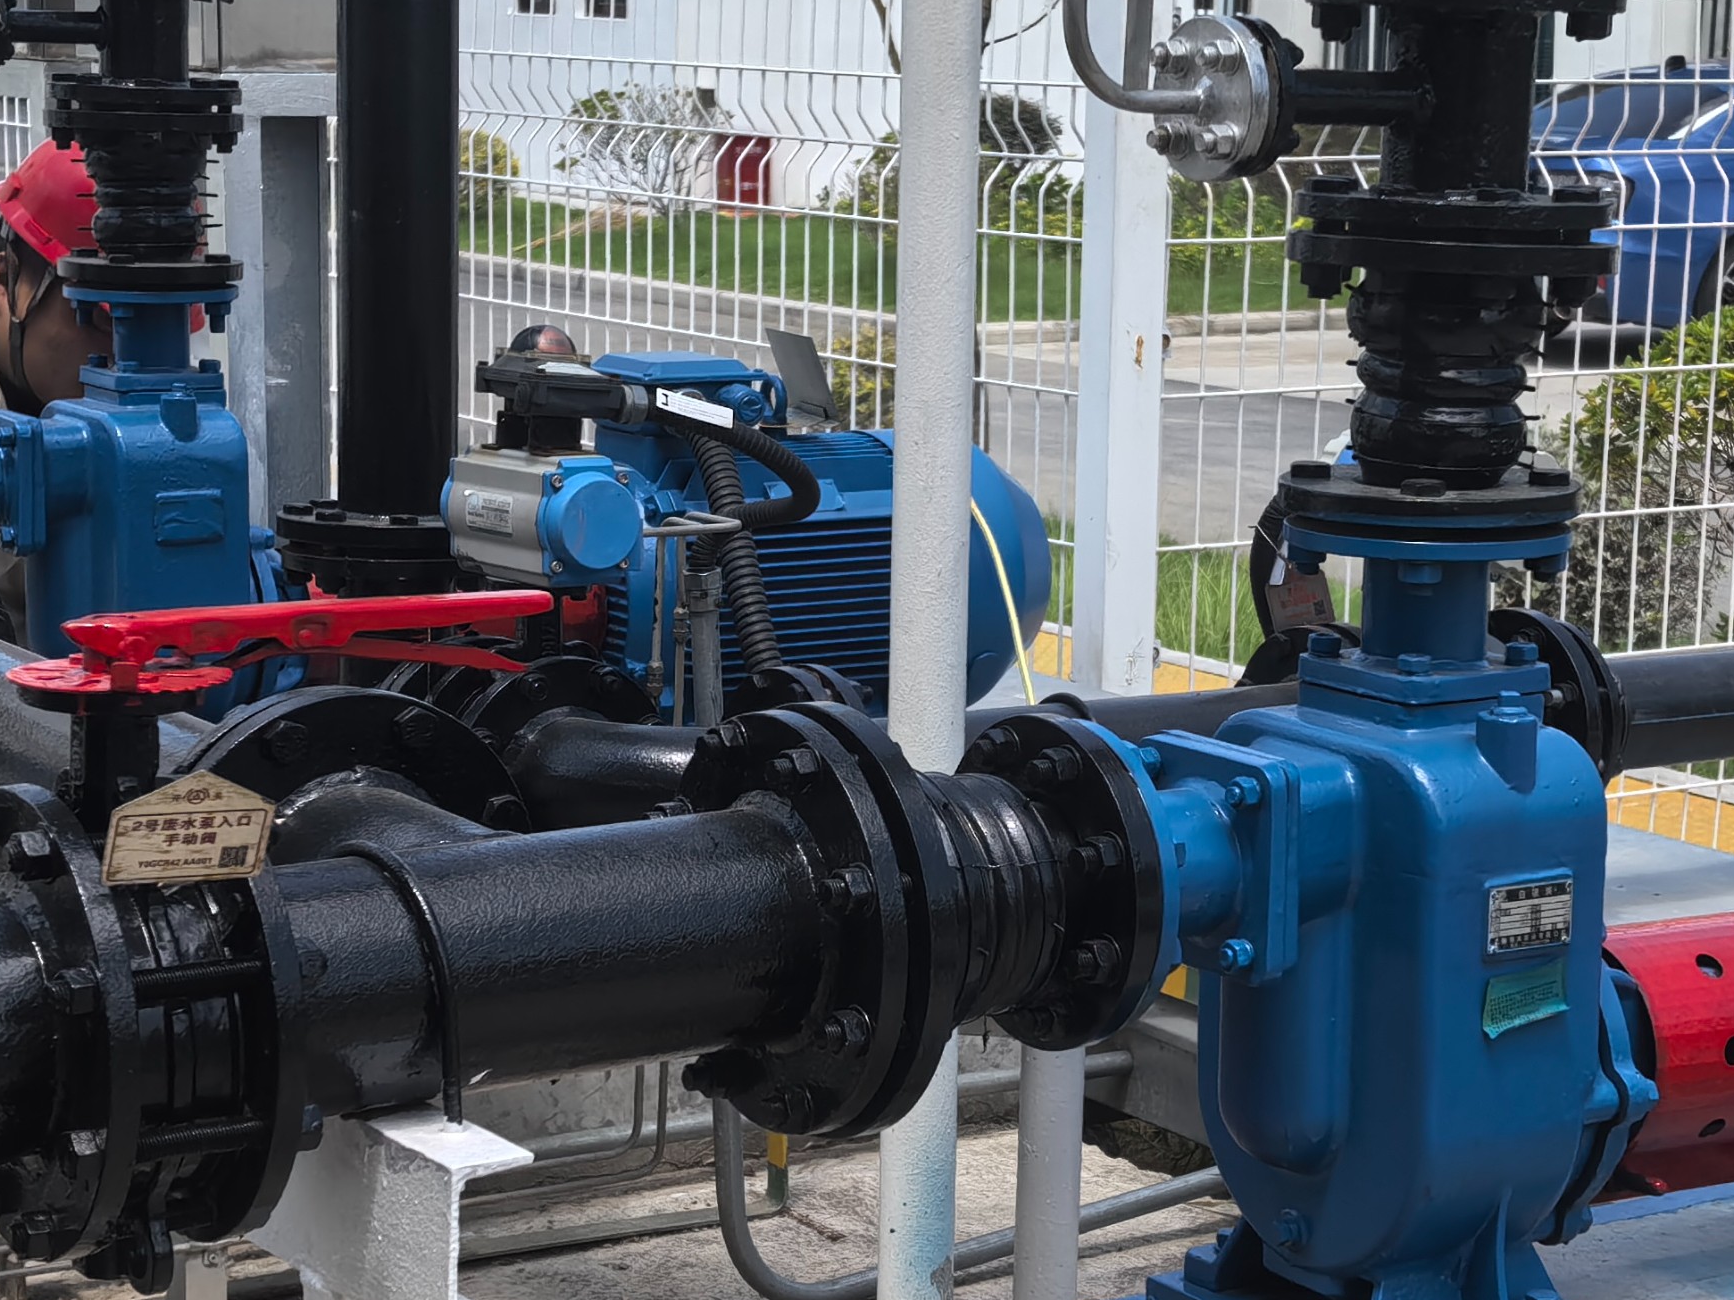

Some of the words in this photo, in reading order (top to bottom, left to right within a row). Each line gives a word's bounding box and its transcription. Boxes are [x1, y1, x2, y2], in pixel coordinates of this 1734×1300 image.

[131, 814, 253, 832] 2号废水泵入口
[162, 832, 217, 847] 手动阀
